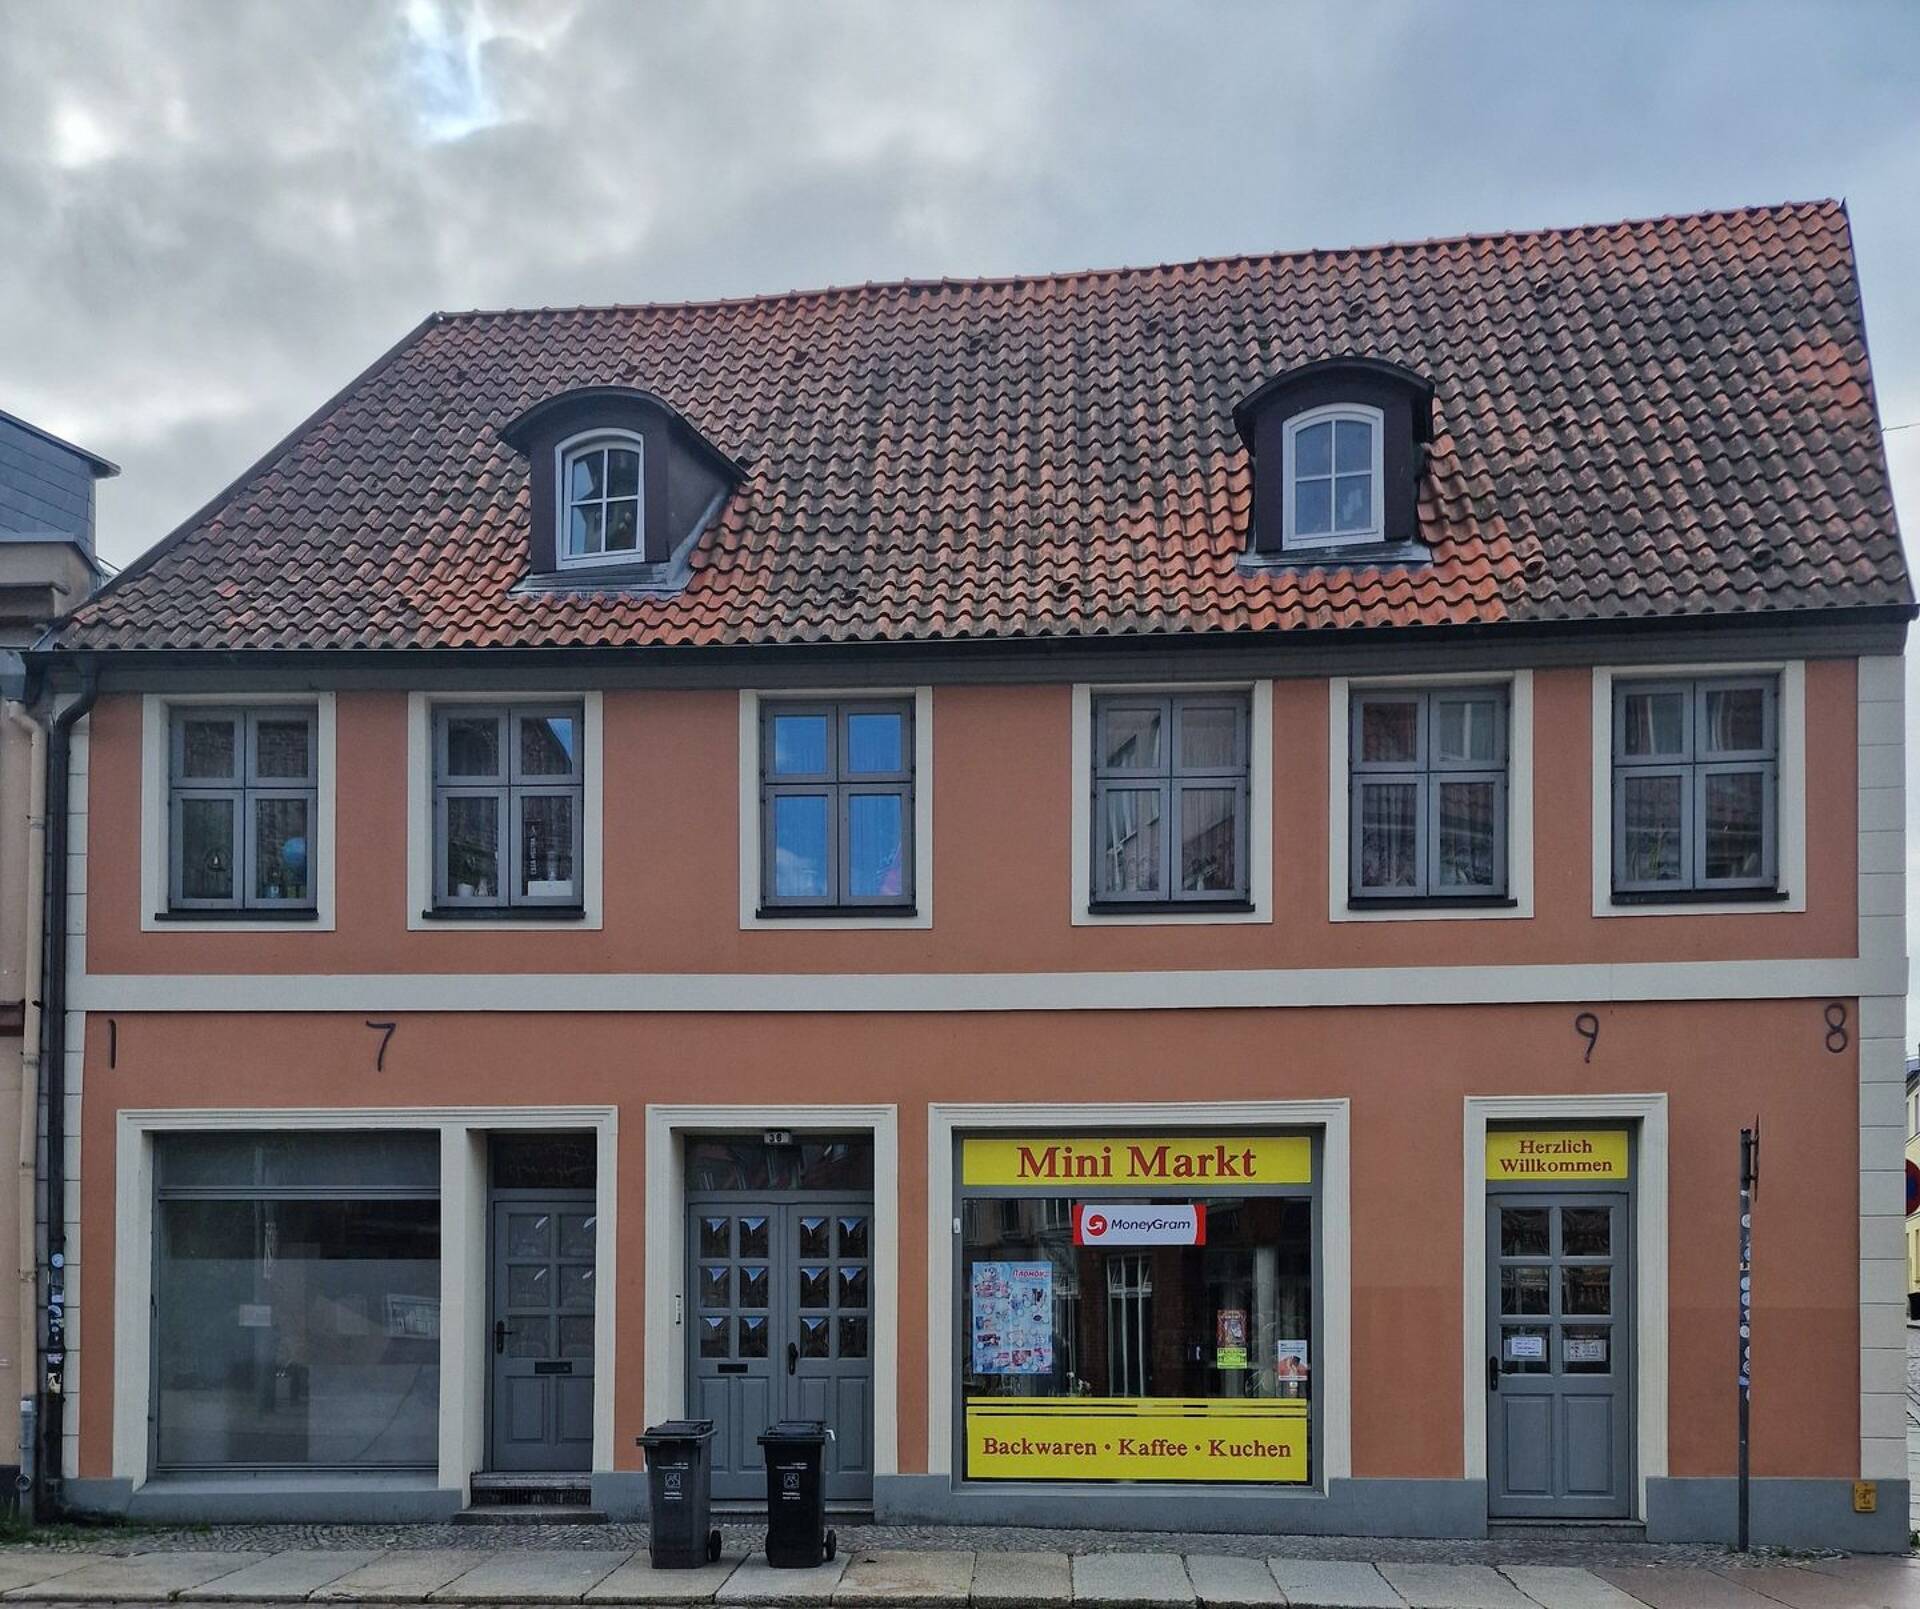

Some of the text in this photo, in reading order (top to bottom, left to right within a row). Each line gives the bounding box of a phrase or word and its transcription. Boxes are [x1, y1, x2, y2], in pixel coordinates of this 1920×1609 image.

[365, 1020, 396, 1072] 7
[1575, 1012, 1599, 1063] 9
[1824, 1003, 1848, 1053] 8
[1519, 1140, 1592, 1154] Herzlich
[1017, 1145, 1257, 1178] Mini Markt
[1500, 1159, 1613, 1172] Willkommen
[1111, 1218, 1191, 1232] MoneyGram
[983, 1437, 1291, 1457] Backwaren Kaffee Kuchen
